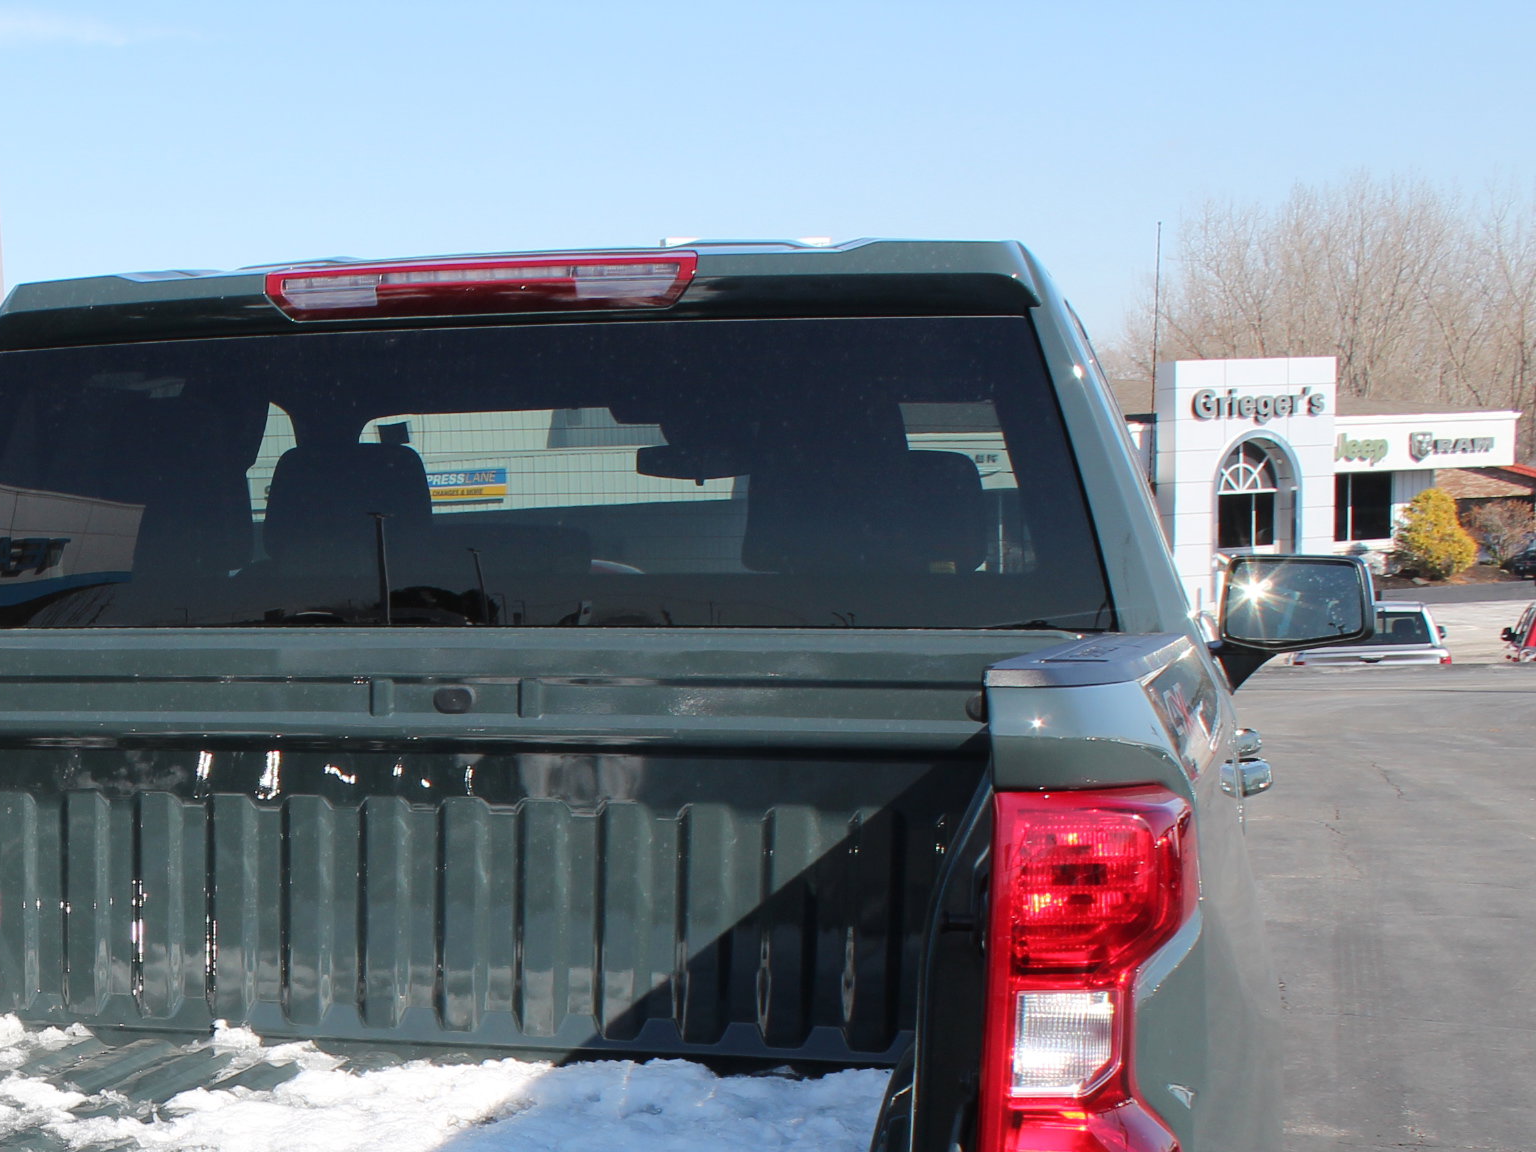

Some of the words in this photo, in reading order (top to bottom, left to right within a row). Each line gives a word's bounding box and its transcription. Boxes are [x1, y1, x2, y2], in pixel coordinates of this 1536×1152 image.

[1192, 386, 1326, 425] Grieger's
[1334, 433, 1389, 467] Jeep
[1433, 437, 1495, 454] RAM
[427, 472, 496, 485] PRESSLANE
